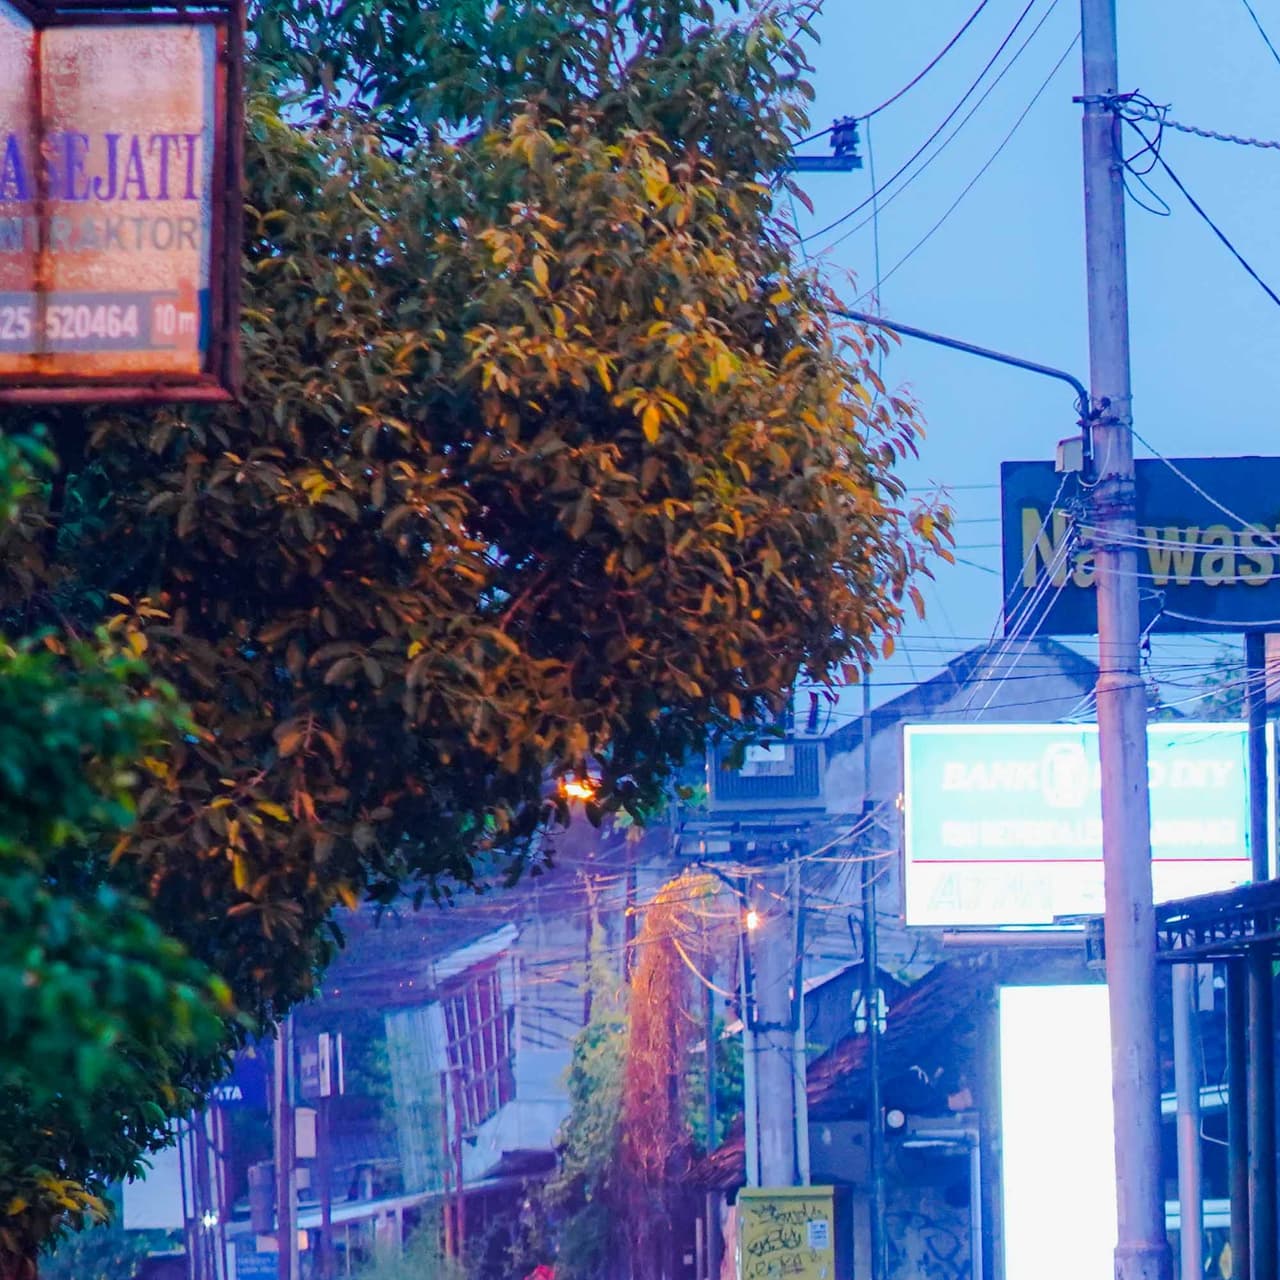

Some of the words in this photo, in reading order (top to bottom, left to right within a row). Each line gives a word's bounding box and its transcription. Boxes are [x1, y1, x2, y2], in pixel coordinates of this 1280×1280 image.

[45, 304, 139, 340] 520464
[943, 761, 1041, 790] BANK
[1169, 760, 1235, 788] DIY
